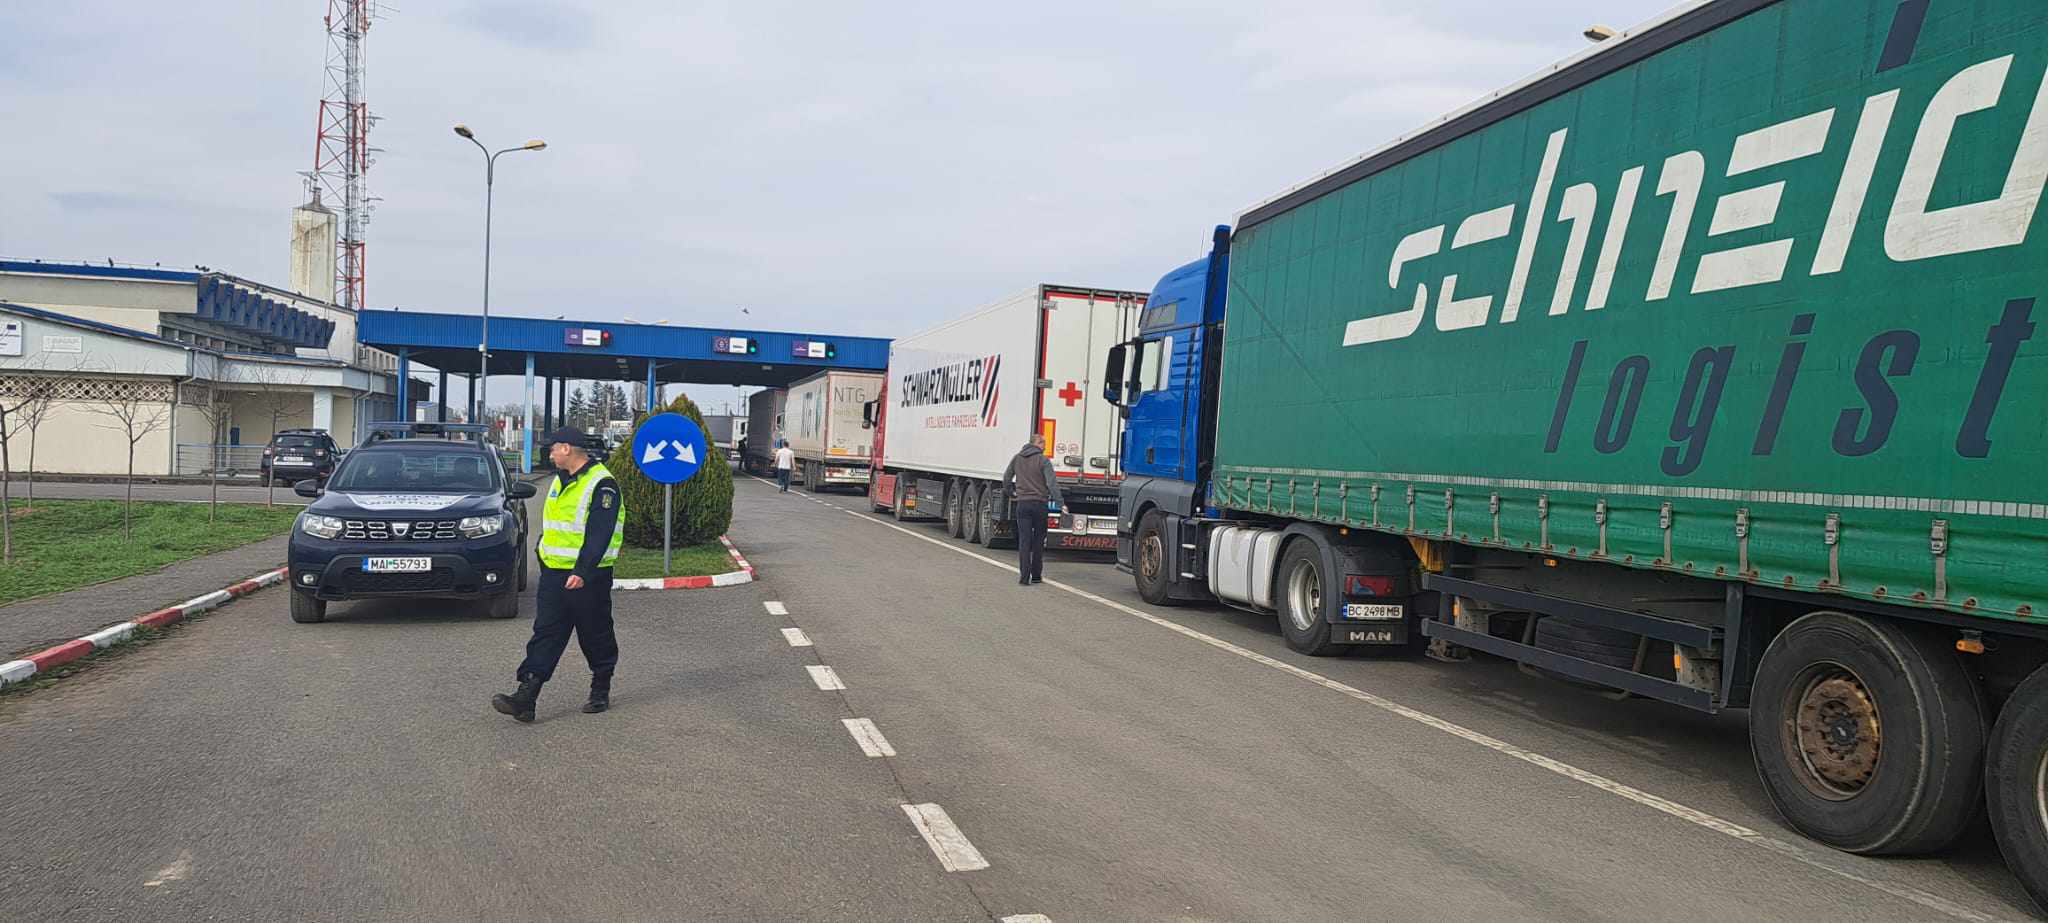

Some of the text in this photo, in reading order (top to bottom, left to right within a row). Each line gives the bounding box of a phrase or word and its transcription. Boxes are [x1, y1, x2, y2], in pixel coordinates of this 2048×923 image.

[901, 359, 982, 408] SCHWARZMÜLLER
[1543, 297, 2036, 476] logist
[834, 385, 867, 403] NTG
[371, 559, 428, 570] MAI 55793
[1348, 606, 1401, 617] BC 2498 MB
[1350, 631, 1392, 641] MAN
